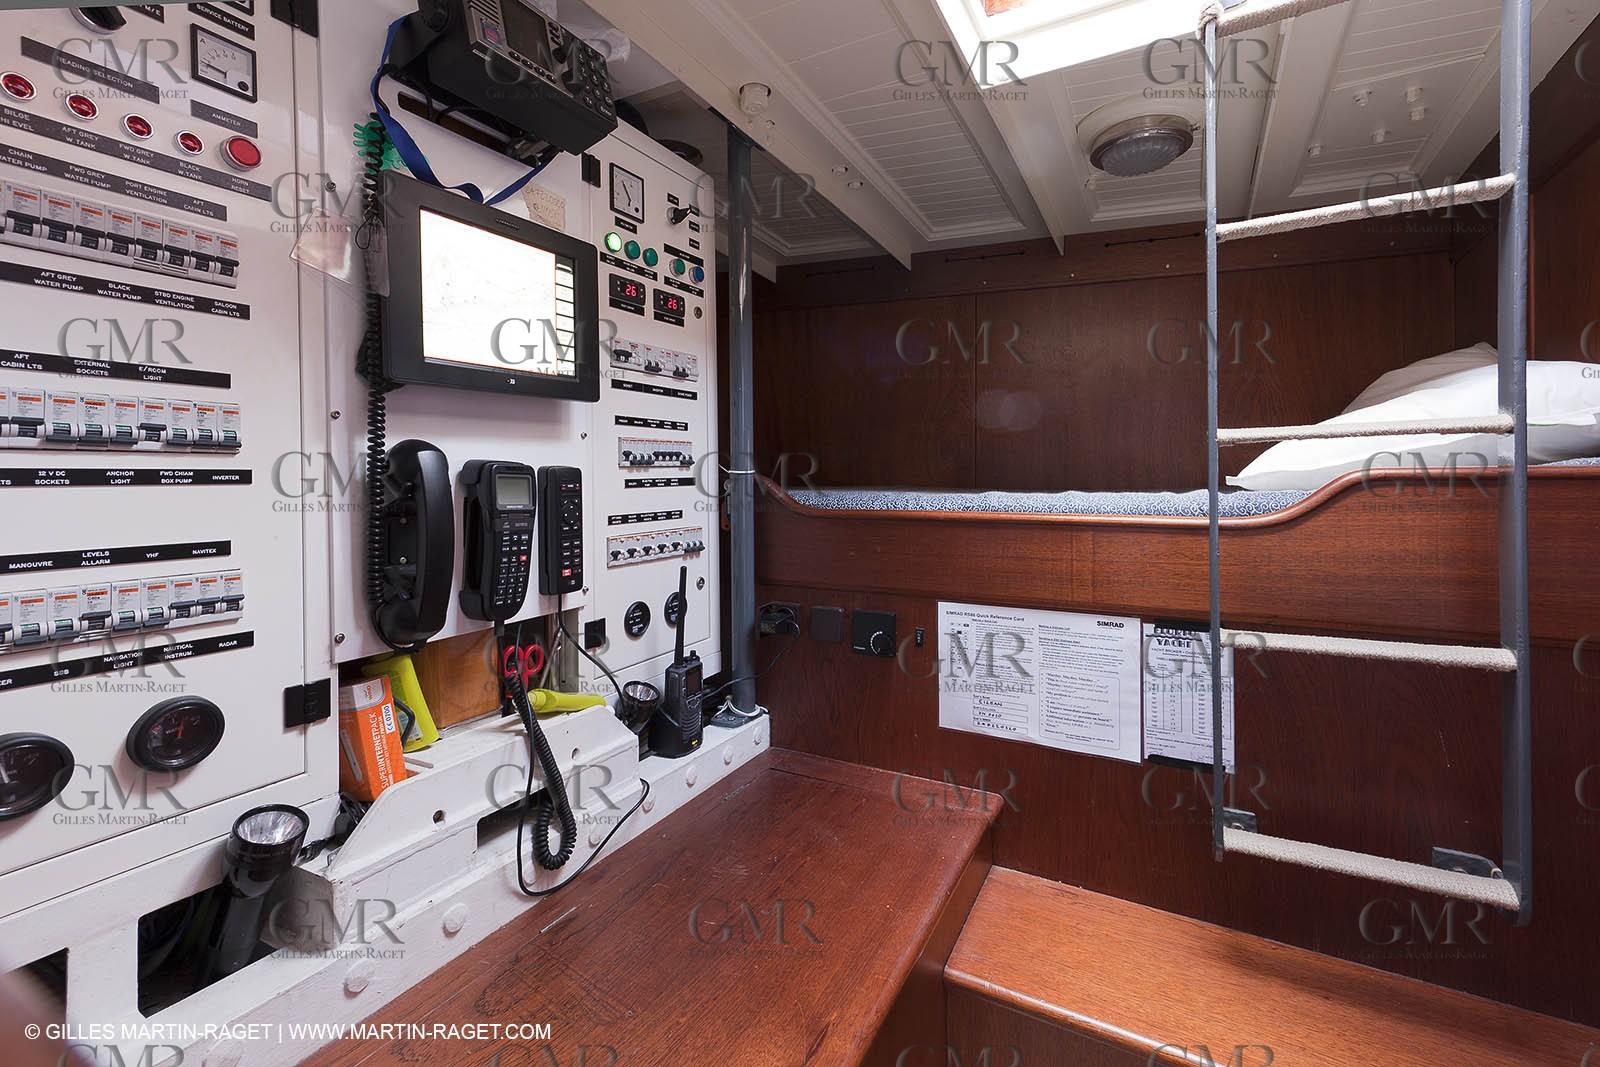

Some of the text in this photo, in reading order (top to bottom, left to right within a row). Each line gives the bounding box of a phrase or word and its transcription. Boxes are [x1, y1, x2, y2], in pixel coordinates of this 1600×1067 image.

[196, 4, 249, 32] SERVICE BATTERY
[56, 56, 133, 89] HEADING SELECTION
[212, 114, 240, 126] AMMETER
[79, 131, 99, 140] GREY
[66, 136, 96, 149] W.TANK
[8, 149, 33, 160] CHAIN
[120, 144, 154, 158] FWD GREY
[0, 156, 48, 172] ATER PUMP
[124, 153, 150, 165] W.TANK
[69, 166, 105, 179] FWD GREY
[180, 162, 200, 172] BLACK
[178, 169, 202, 180] W.TANK
[64, 172, 111, 189] WATER PUMP
[232, 178, 249, 186] HORN
[125, 181, 168, 196] PORT ENGINE
[231, 185, 249, 194] RESET
[125, 189, 168, 204] VENTILATION
[184, 204, 214, 216] CABIN LTS
[57, 274, 77, 282] GREY
[34, 278, 84, 291] WATER PUMP
[109, 282, 130, 291] BLACK
[97, 289, 120, 298] WATER
[625, 284, 637, 297] 26
[173, 293, 195, 302] ENGINE
[155, 299, 195, 309] VENTILATION
[214, 301, 237, 309] SALOON
[667, 298, 678, 310] 26
[74, 360, 110, 368] EXTERNAL
[76, 368, 109, 376] SOCKETS
[9, 561, 53, 569] MANOUVRE
[1097, 620, 1124, 628] SIMRAD
[164, 643, 193, 652] NAUTICAL
[1156, 638, 1192, 648] YACHT
[104, 652, 142, 662] NAVIGATION
[113, 661, 134, 669] LIGHT
[384, 706, 393, 721] 0700
[369, 712, 389, 788] SUPERINTERNETPACK
